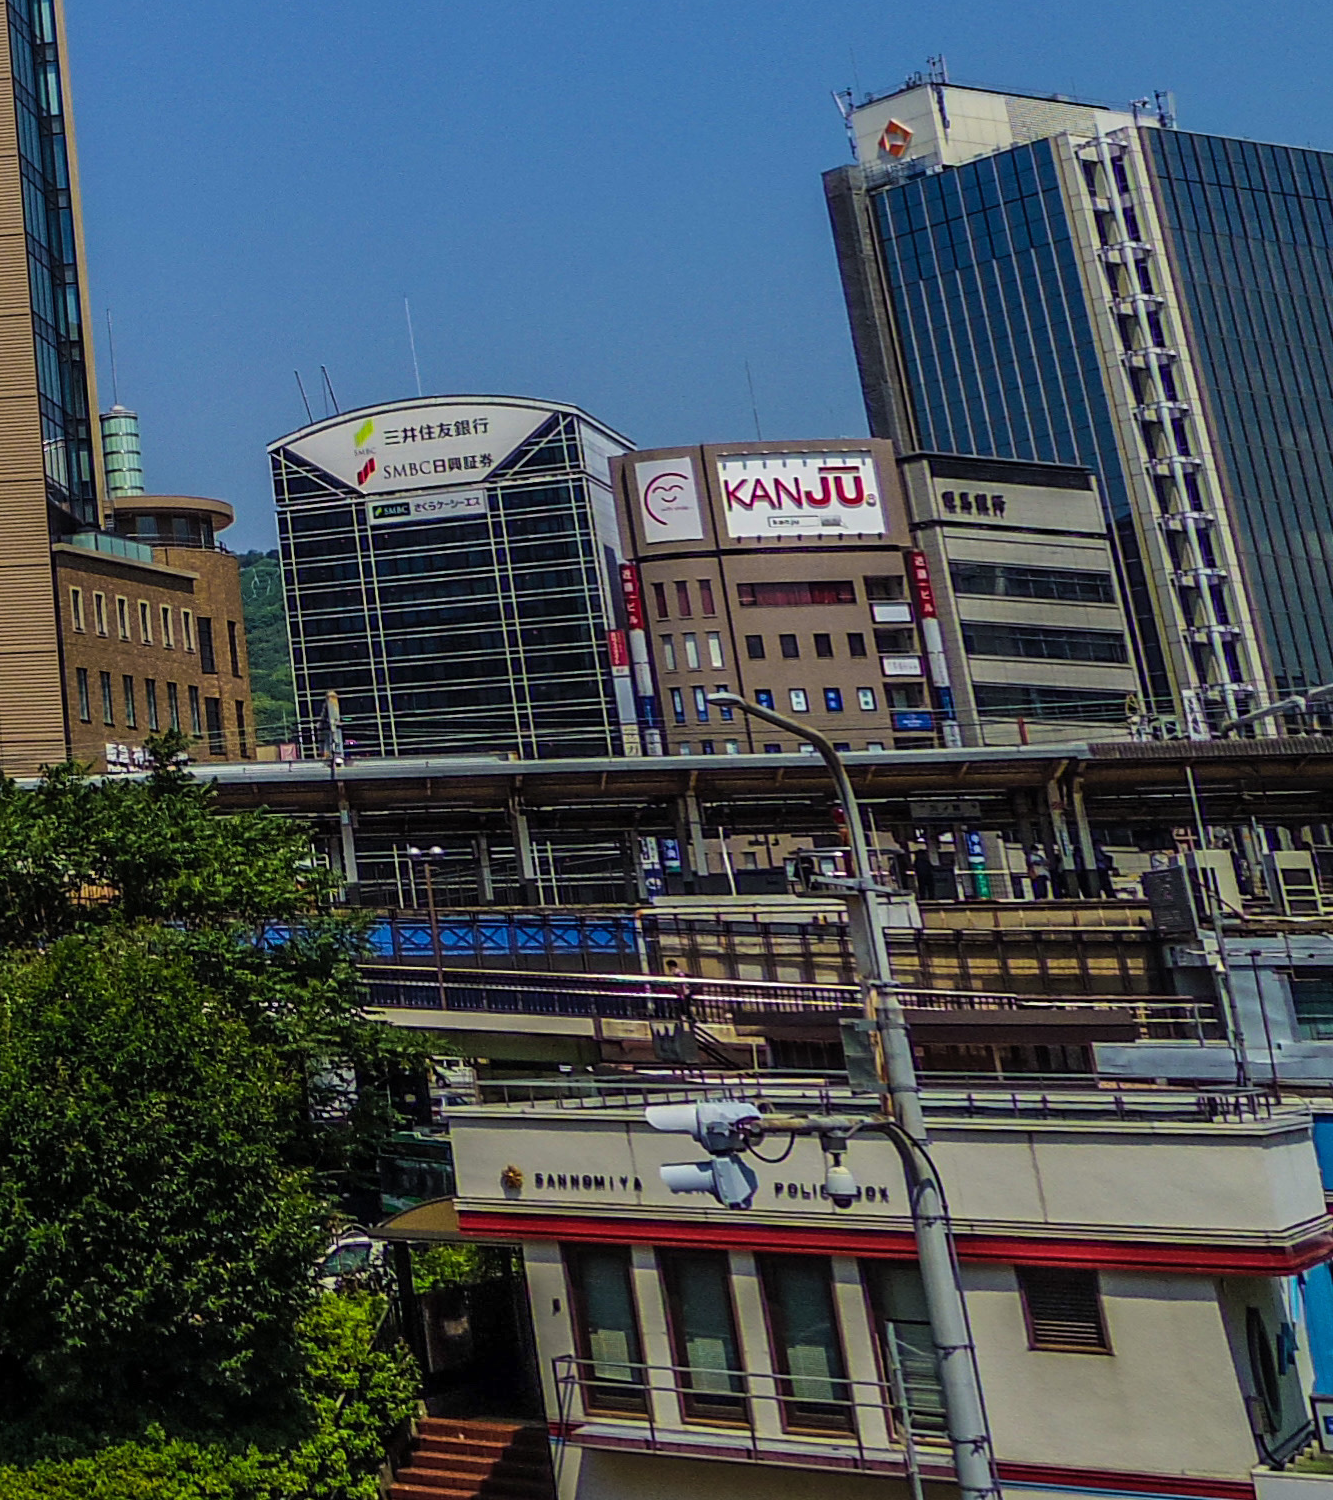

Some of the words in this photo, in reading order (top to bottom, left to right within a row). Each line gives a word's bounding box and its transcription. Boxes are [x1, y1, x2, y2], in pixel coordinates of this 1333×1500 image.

[383, 417, 490, 446] 三井住友銀行
[383, 453, 494, 480] SMBC日興証券
[383, 504, 409, 515] SMBC
[413, 497, 482, 513] さくらケーシーエス
[534, 1172, 644, 1192] SANNOMIYA
[774, 1182, 831, 1201] POLIC
